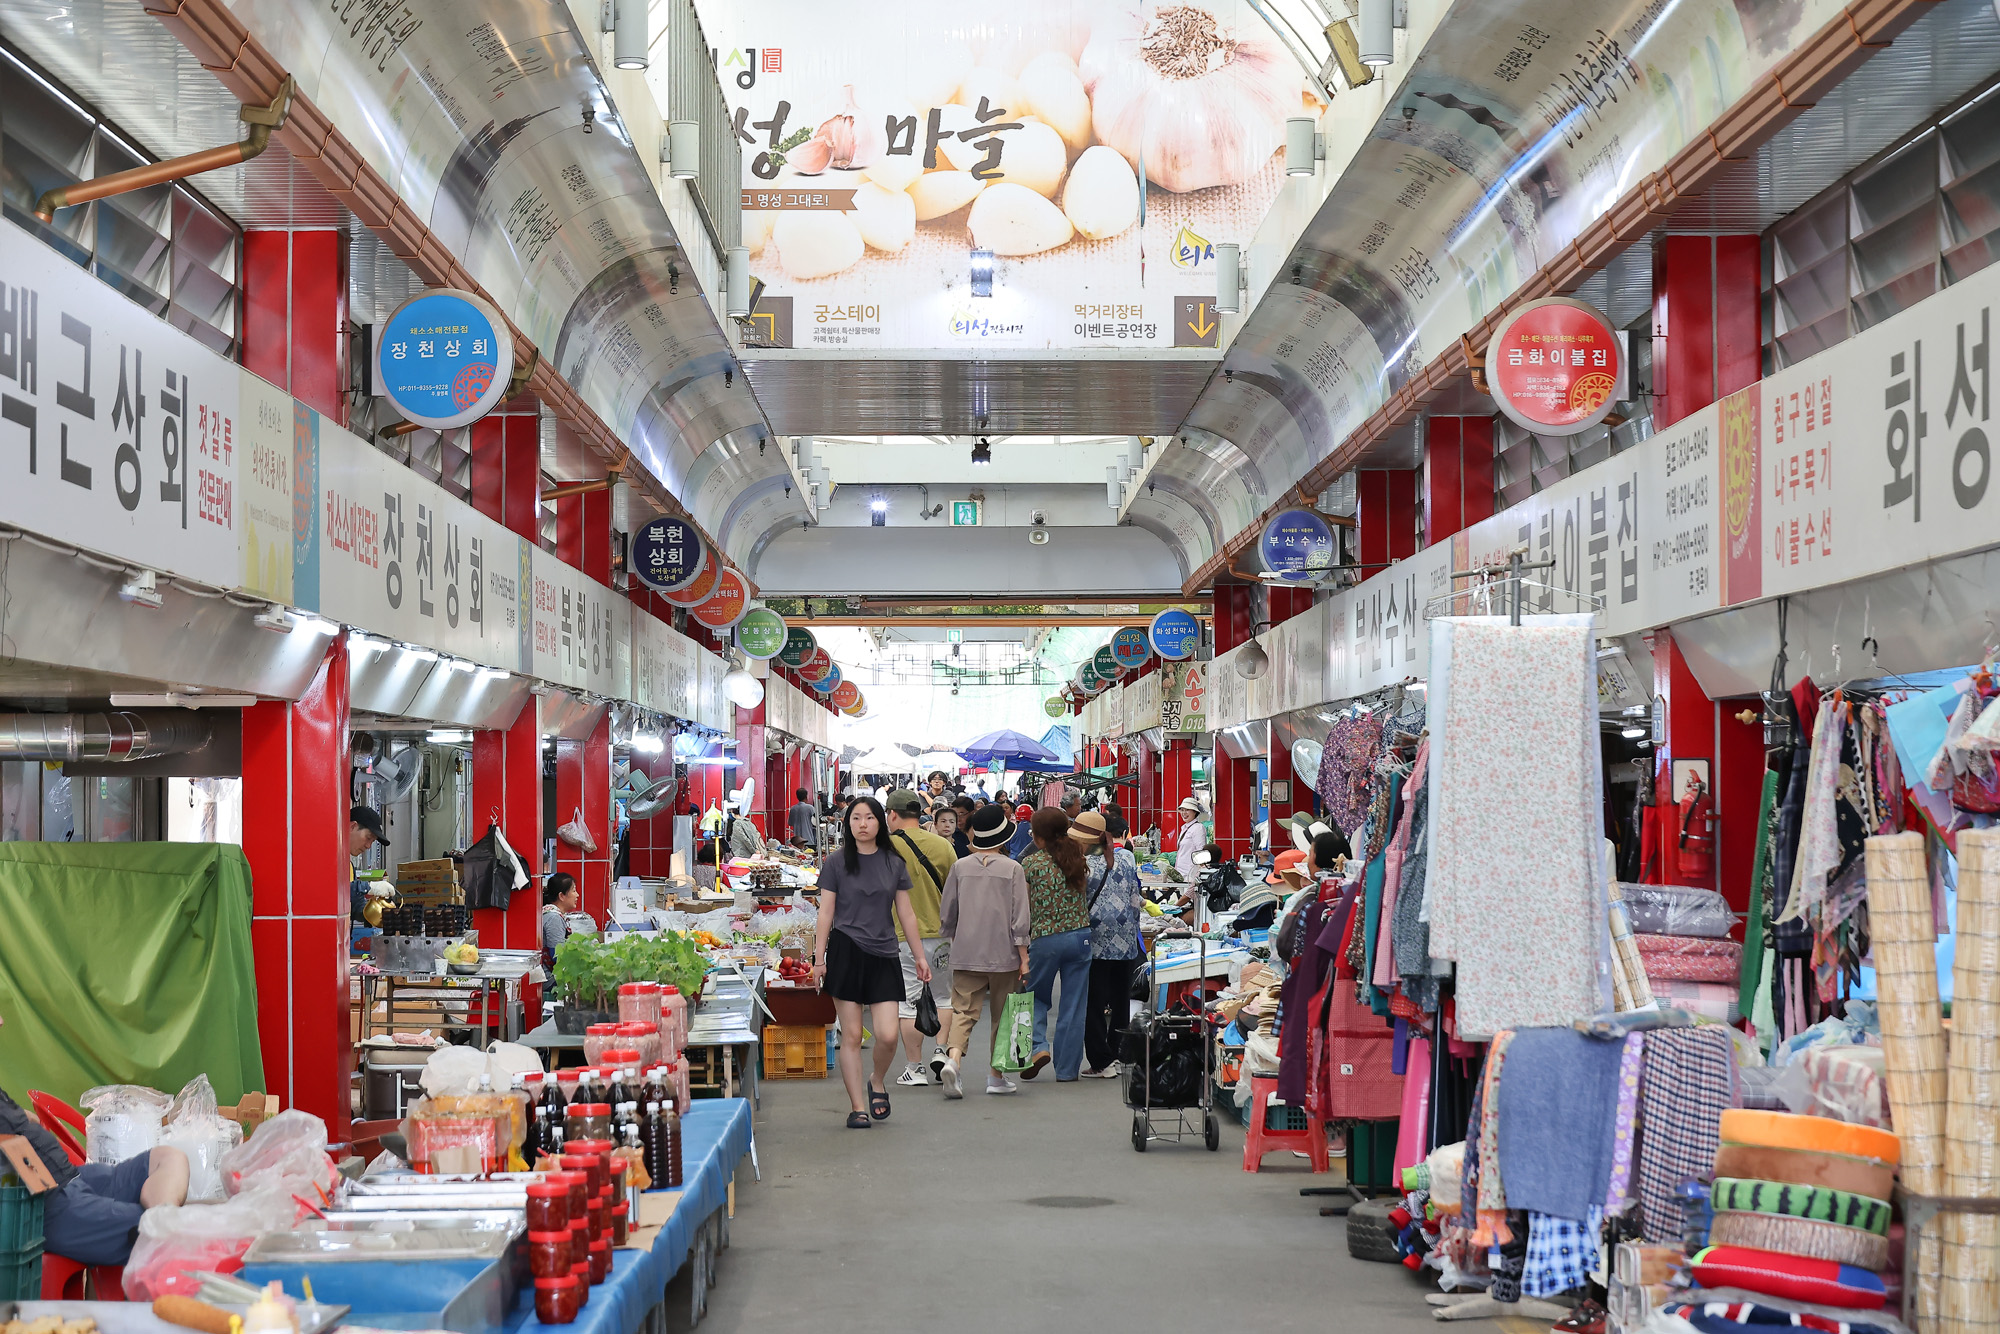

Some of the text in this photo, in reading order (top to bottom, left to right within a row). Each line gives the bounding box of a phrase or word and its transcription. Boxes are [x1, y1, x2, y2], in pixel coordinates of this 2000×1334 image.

[886, 96, 1025, 182] 마늘
[758, 194, 782, 208] 명성
[785, 194, 829, 208] 그대로!
[813, 304, 881, 323] 궁스테이
[1074, 304, 1143, 319] 먹거리장터
[409, 325, 469, 335] 채소소매전문점
[813, 326, 881, 335] 고객쉼터.특산물판매장
[955, 318, 1024, 337] 의성 전통시장
[1074, 323, 1158, 338] 이벤트공연장
[813, 335, 848, 343] 카페.방송실
[391, 338, 488, 360] 장천상회
[1507, 348, 1607, 367] 금화이불집
[1773, 374, 1832, 445] 침구일절
[1883, 306, 1990, 523] 화성
[198, 403, 232, 468] 젓갈류
[252, 442, 287, 496] 의성전통시장
[1773, 440, 1832, 506] 나무목기
[198, 469, 232, 531] 전문판매
[326, 489, 379, 569] 채소소매전문점
[648, 525, 683, 544] 복현
[1774, 507, 1832, 568] 이불수선
[1269, 535, 1327, 547] 부산수산
[383, 492, 484, 639] 장천상회
[648, 547, 683, 566] 상회
[561, 585, 614, 680] 복현상회
[1156, 627, 1195, 635] 화성천막사
[1355, 573, 1416, 678] 부산수산
[1120, 633, 1140, 643] 의성
[1118, 645, 1145, 657] 채소
